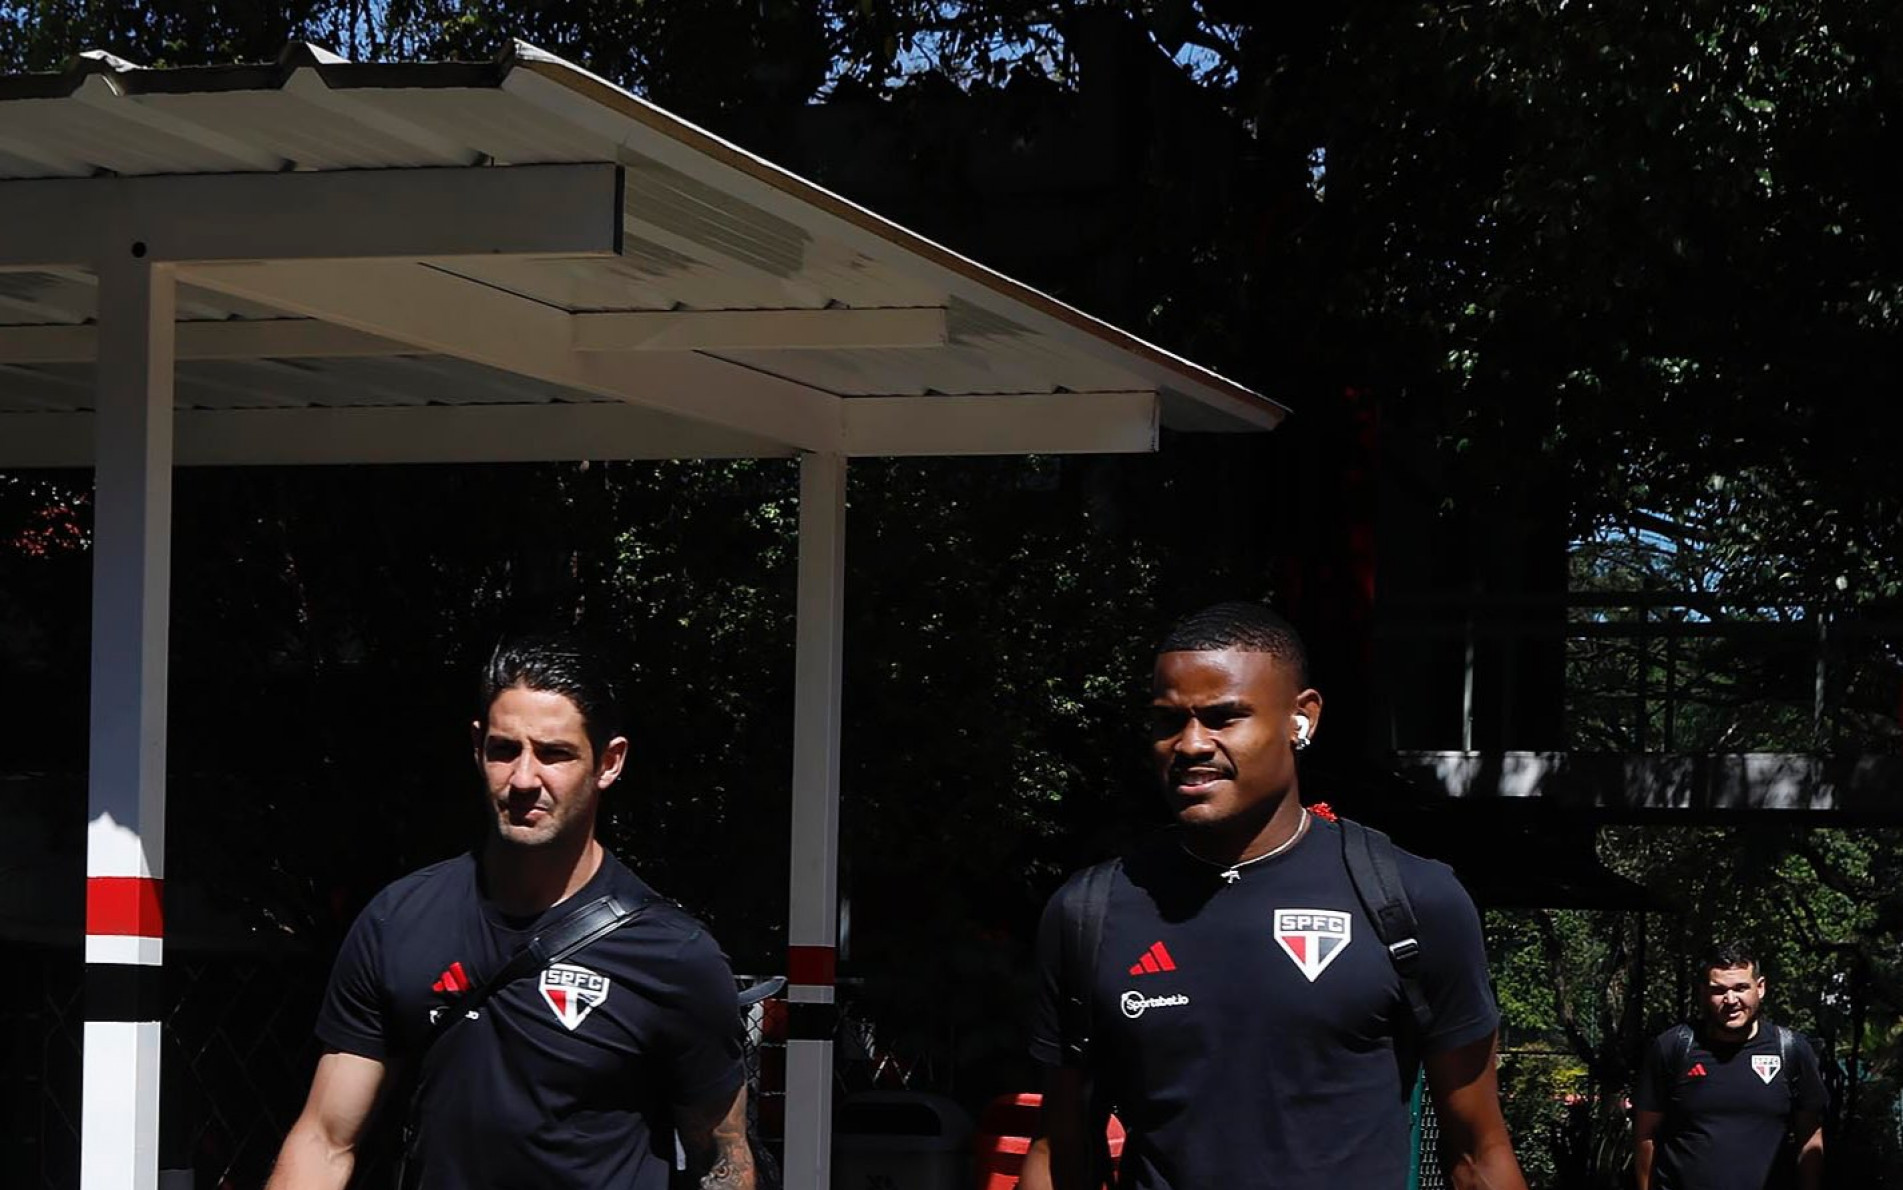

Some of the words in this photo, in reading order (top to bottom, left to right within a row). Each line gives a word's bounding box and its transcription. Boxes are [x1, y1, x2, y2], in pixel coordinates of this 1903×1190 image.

[1281, 915, 1344, 932] SPFC
[547, 969, 602, 990] SPFC
[1125, 992, 1189, 1012] Sportsbet.io
